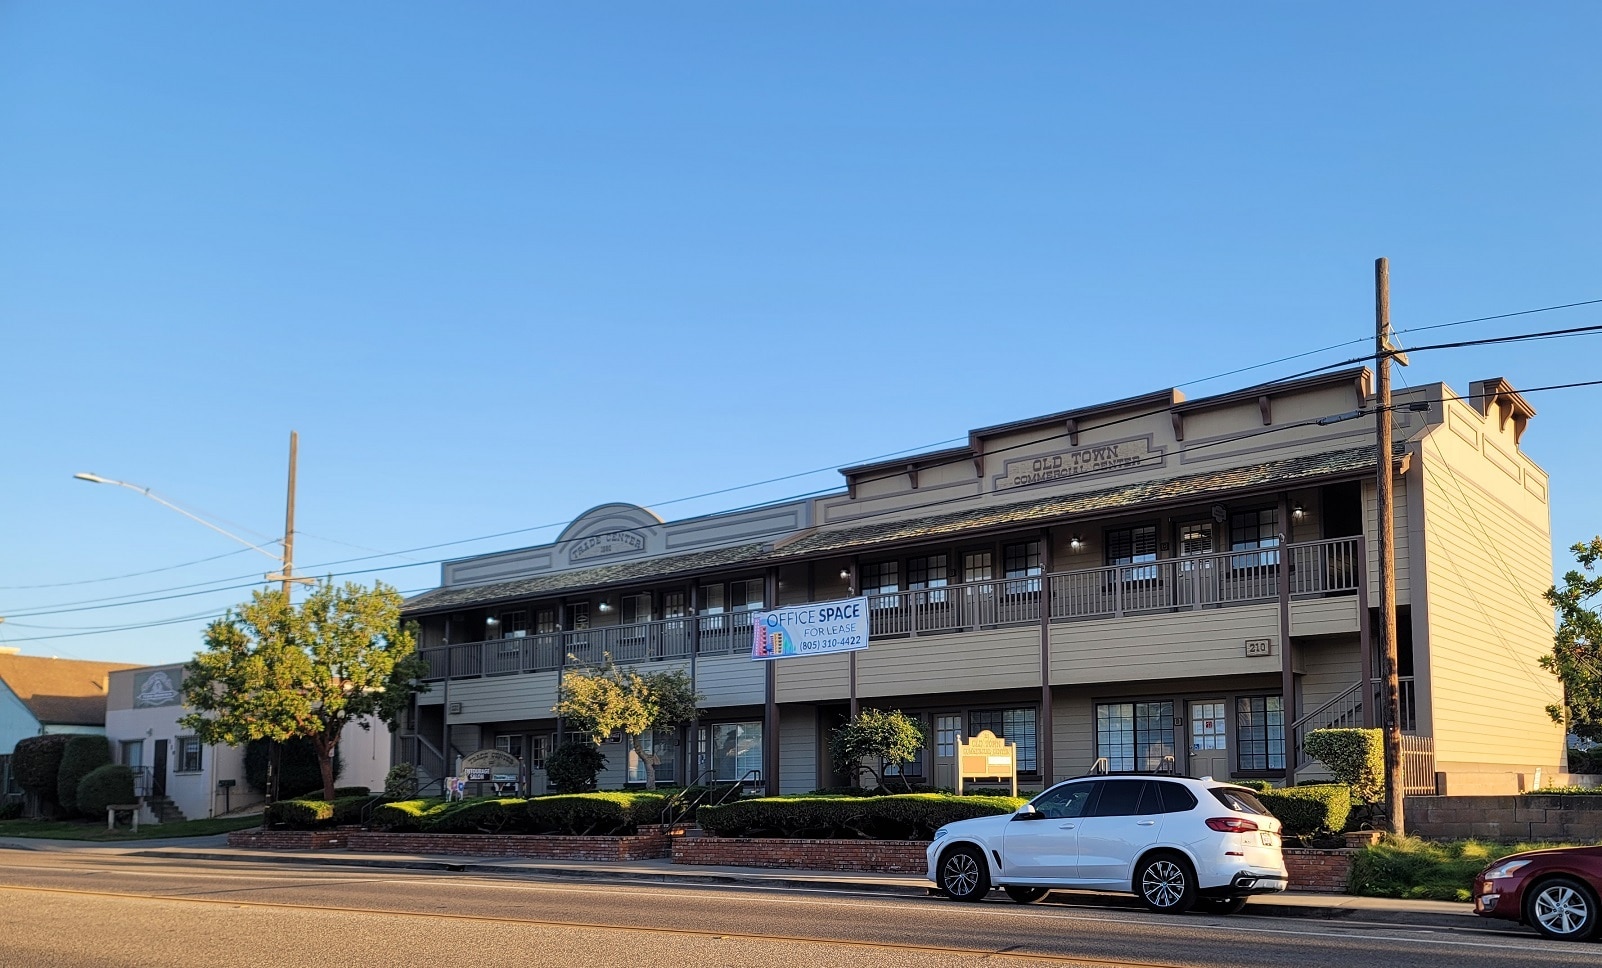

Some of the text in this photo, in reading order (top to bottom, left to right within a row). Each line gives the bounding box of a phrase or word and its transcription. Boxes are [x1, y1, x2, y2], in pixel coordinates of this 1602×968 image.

[1014, 456, 1140, 485] COMMERCIAL CENTER
[1033, 446, 1119, 473] OLD TOWN
[573, 533, 640, 558] TRADE CENTER
[767, 603, 860, 627] OFFICE SPACE
[804, 622, 857, 638] FOR LEASE
[800, 635, 861, 652] (805) 310-4422
[1250, 643, 1265, 652] 210
